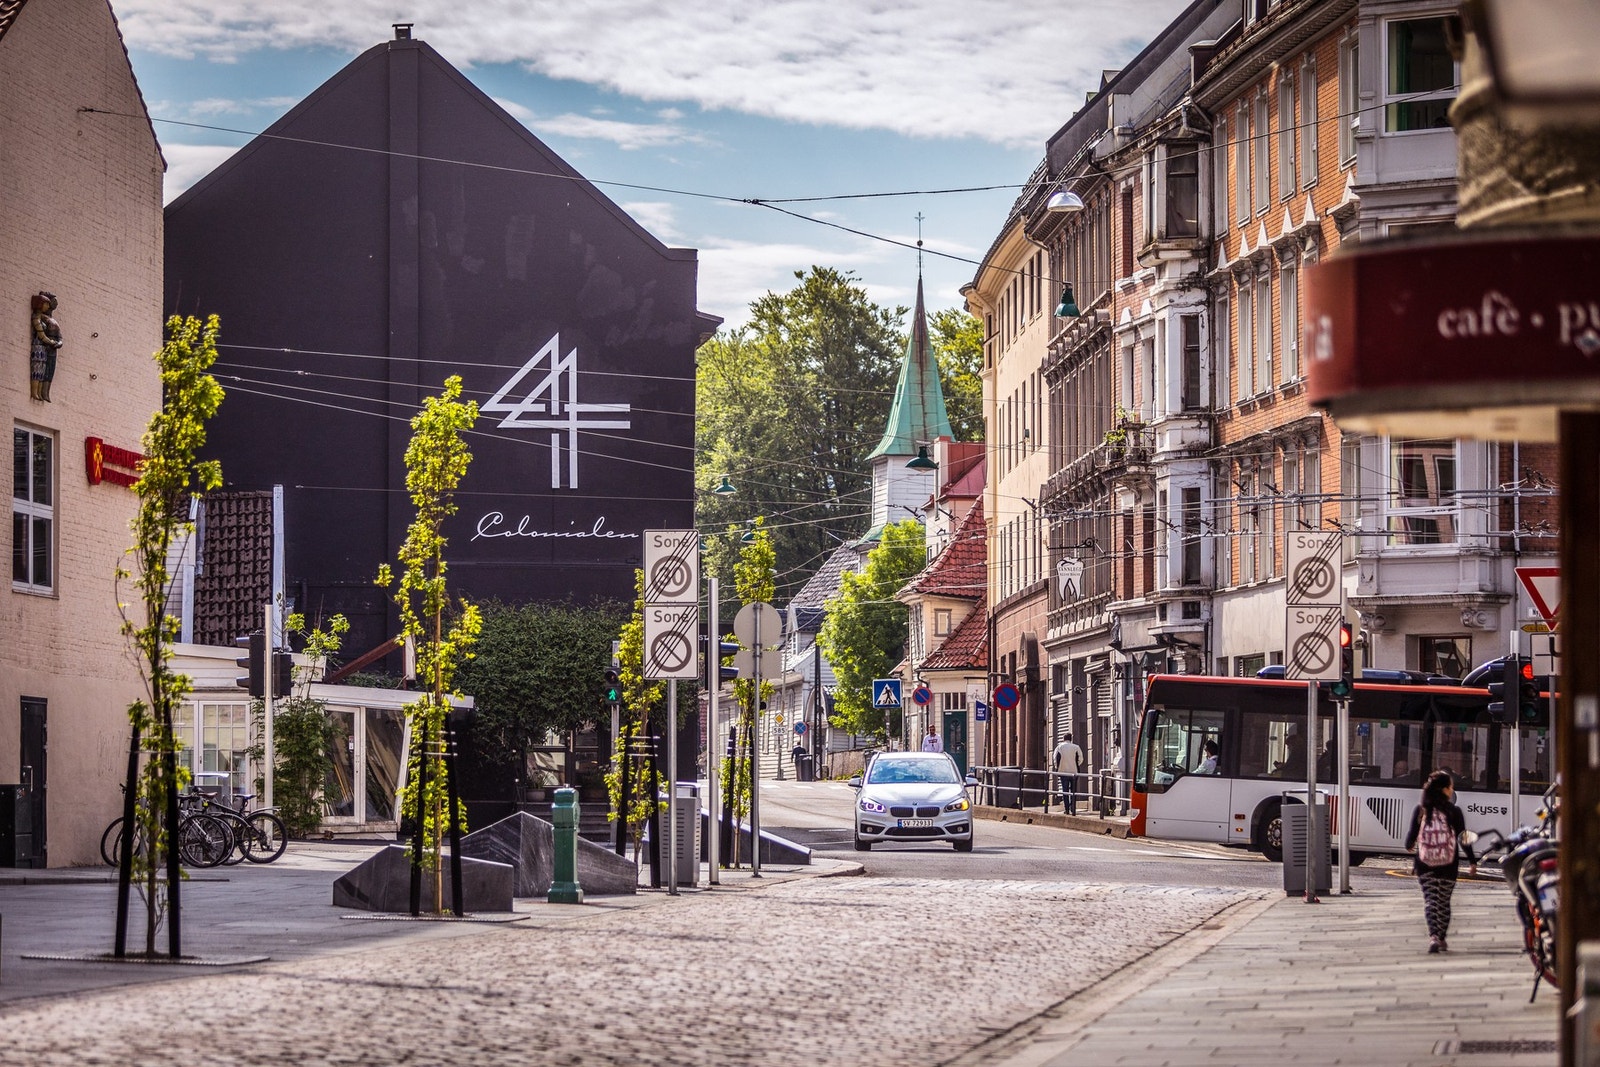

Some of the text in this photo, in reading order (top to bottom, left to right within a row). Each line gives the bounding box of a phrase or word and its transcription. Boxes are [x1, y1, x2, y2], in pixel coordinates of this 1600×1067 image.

[470, 511, 639, 541] Colonialen
[653, 535, 689, 549] Sone
[1296, 535, 1333, 549] Sone
[653, 610, 689, 623] Sone
[1295, 611, 1332, 624] Sone
[1467, 803, 1499, 815] skyss
